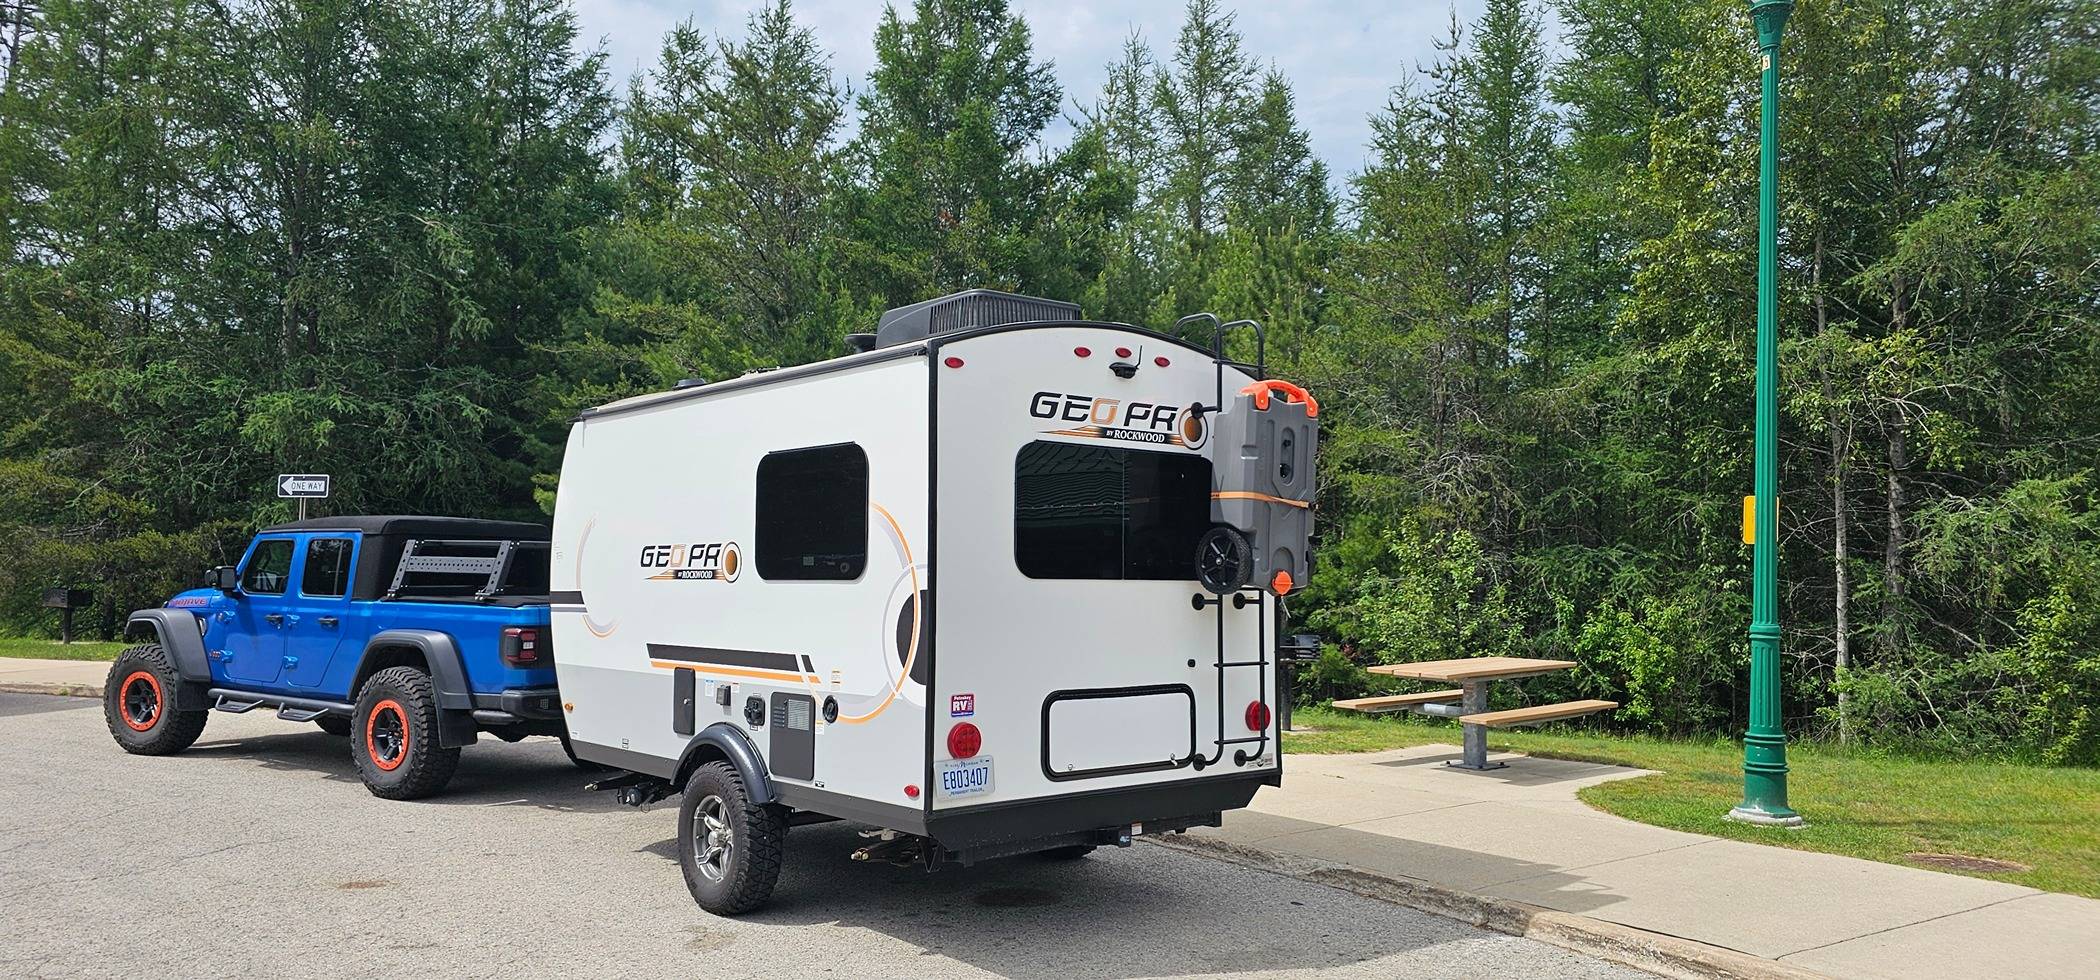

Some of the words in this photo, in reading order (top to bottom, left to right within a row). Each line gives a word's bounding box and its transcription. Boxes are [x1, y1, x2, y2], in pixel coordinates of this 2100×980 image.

[1030, 391, 1120, 425] GEO
[1123, 402, 1208, 450] PRO
[1114, 429, 1165, 443] ROCKWOOD
[291, 481, 306, 490] ONE
[307, 481, 323, 490] WAY
[640, 543, 686, 568] GEO
[687, 541, 742, 583] PRO
[682, 570, 713, 579] ROCKWOOD
[952, 700, 968, 712] RV
[943, 767, 988, 790] E803407
